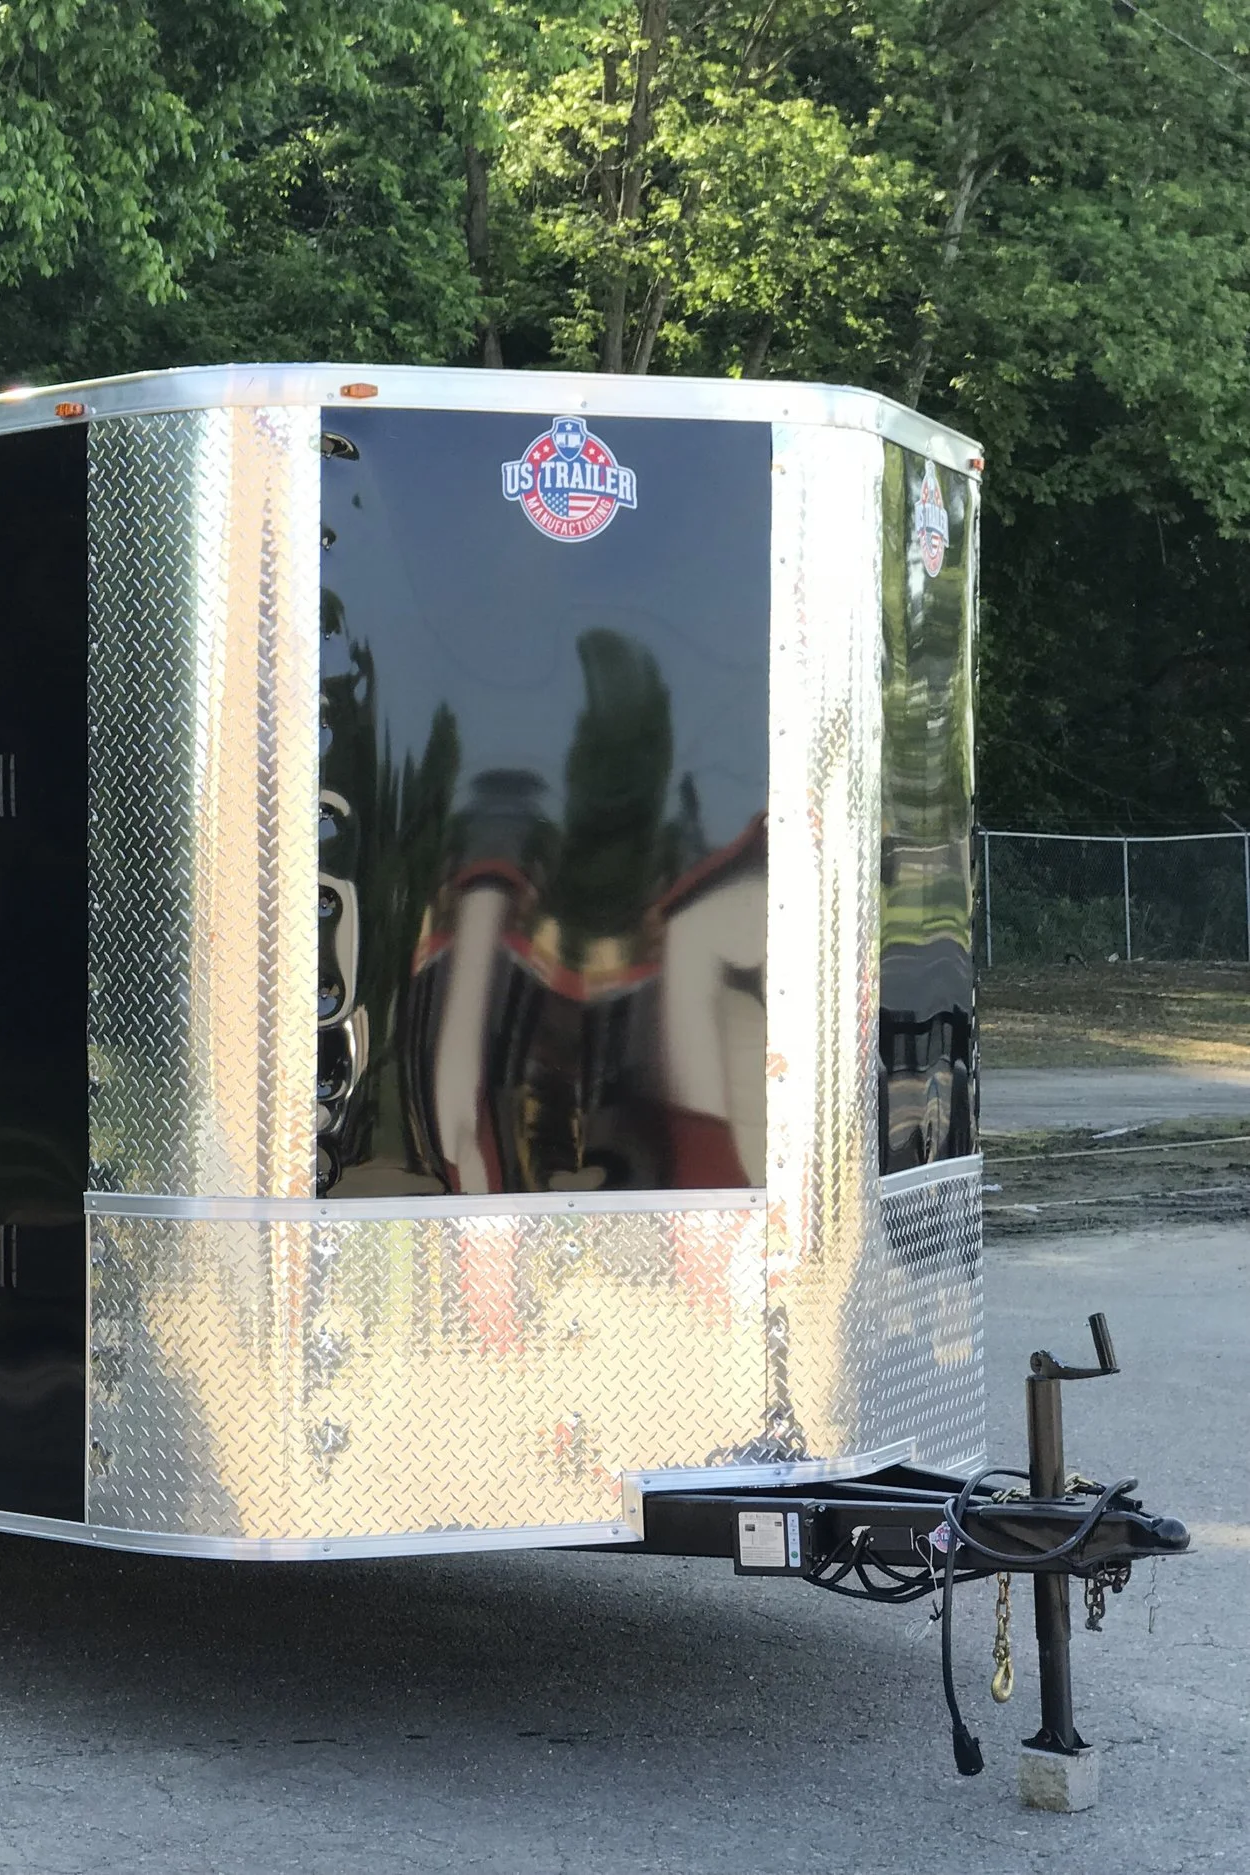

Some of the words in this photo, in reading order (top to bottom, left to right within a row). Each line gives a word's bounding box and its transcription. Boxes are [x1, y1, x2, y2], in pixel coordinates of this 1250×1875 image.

[506, 462, 533, 494] US
[541, 461, 632, 501] TRAILER
[527, 496, 612, 535] MANUFACTURING
